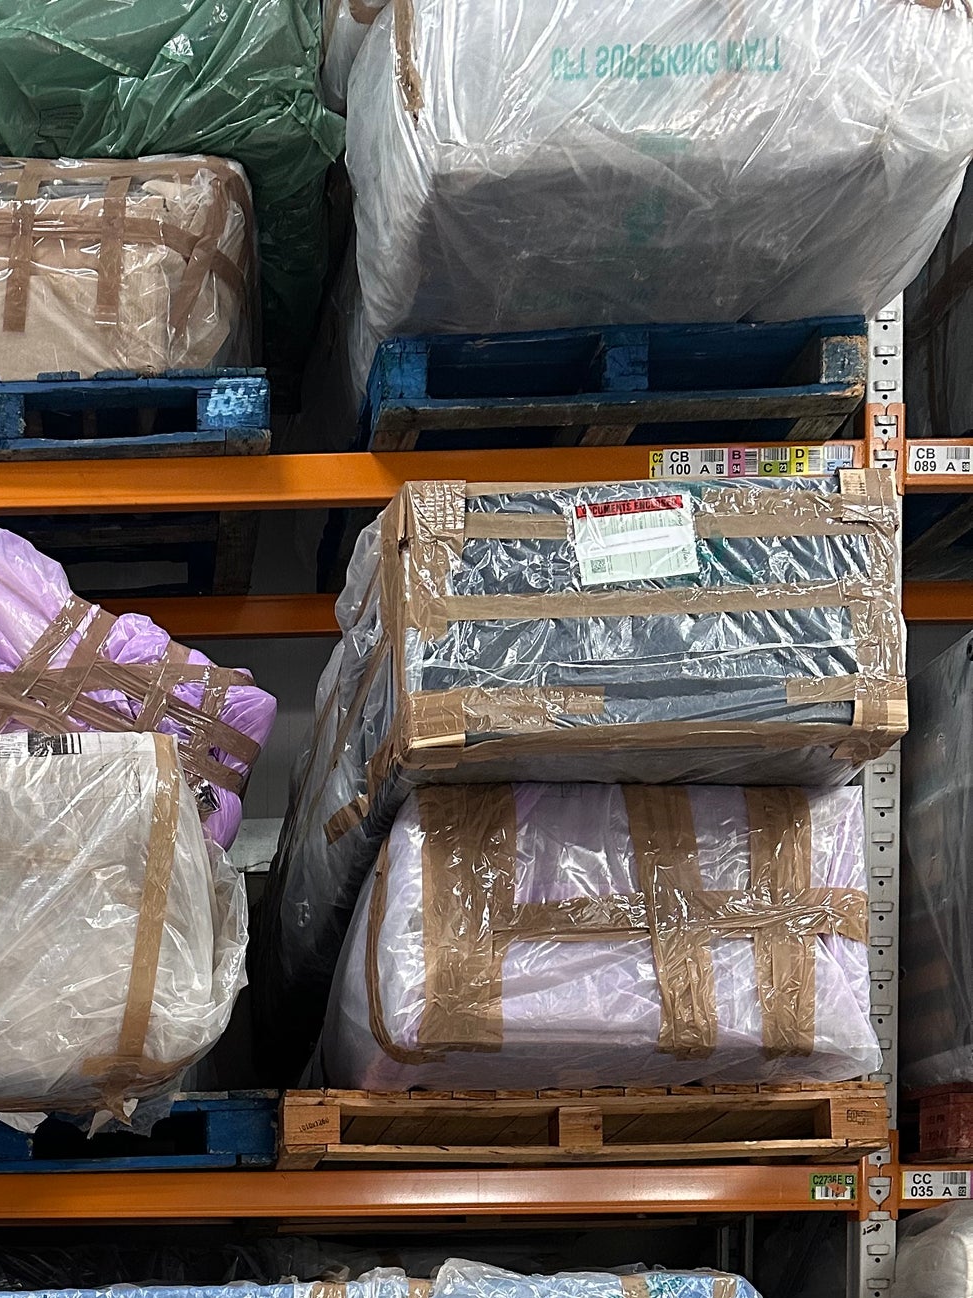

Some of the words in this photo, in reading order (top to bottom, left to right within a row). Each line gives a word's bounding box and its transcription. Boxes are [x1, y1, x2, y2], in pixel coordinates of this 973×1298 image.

[670, 451, 689, 462] CB
[732, 450, 741, 460] B
[795, 448, 805, 459] D
[916, 448, 935, 459] CB
[669, 463, 691, 475] 100
[699, 464, 710, 474] A
[763, 463, 773, 473] C
[914, 460, 937, 472] 089
[945, 462, 956, 472] A
[912, 1173, 932, 1185] CC
[910, 1186, 933, 1197] 035
[942, 1187, 952, 1197] A
